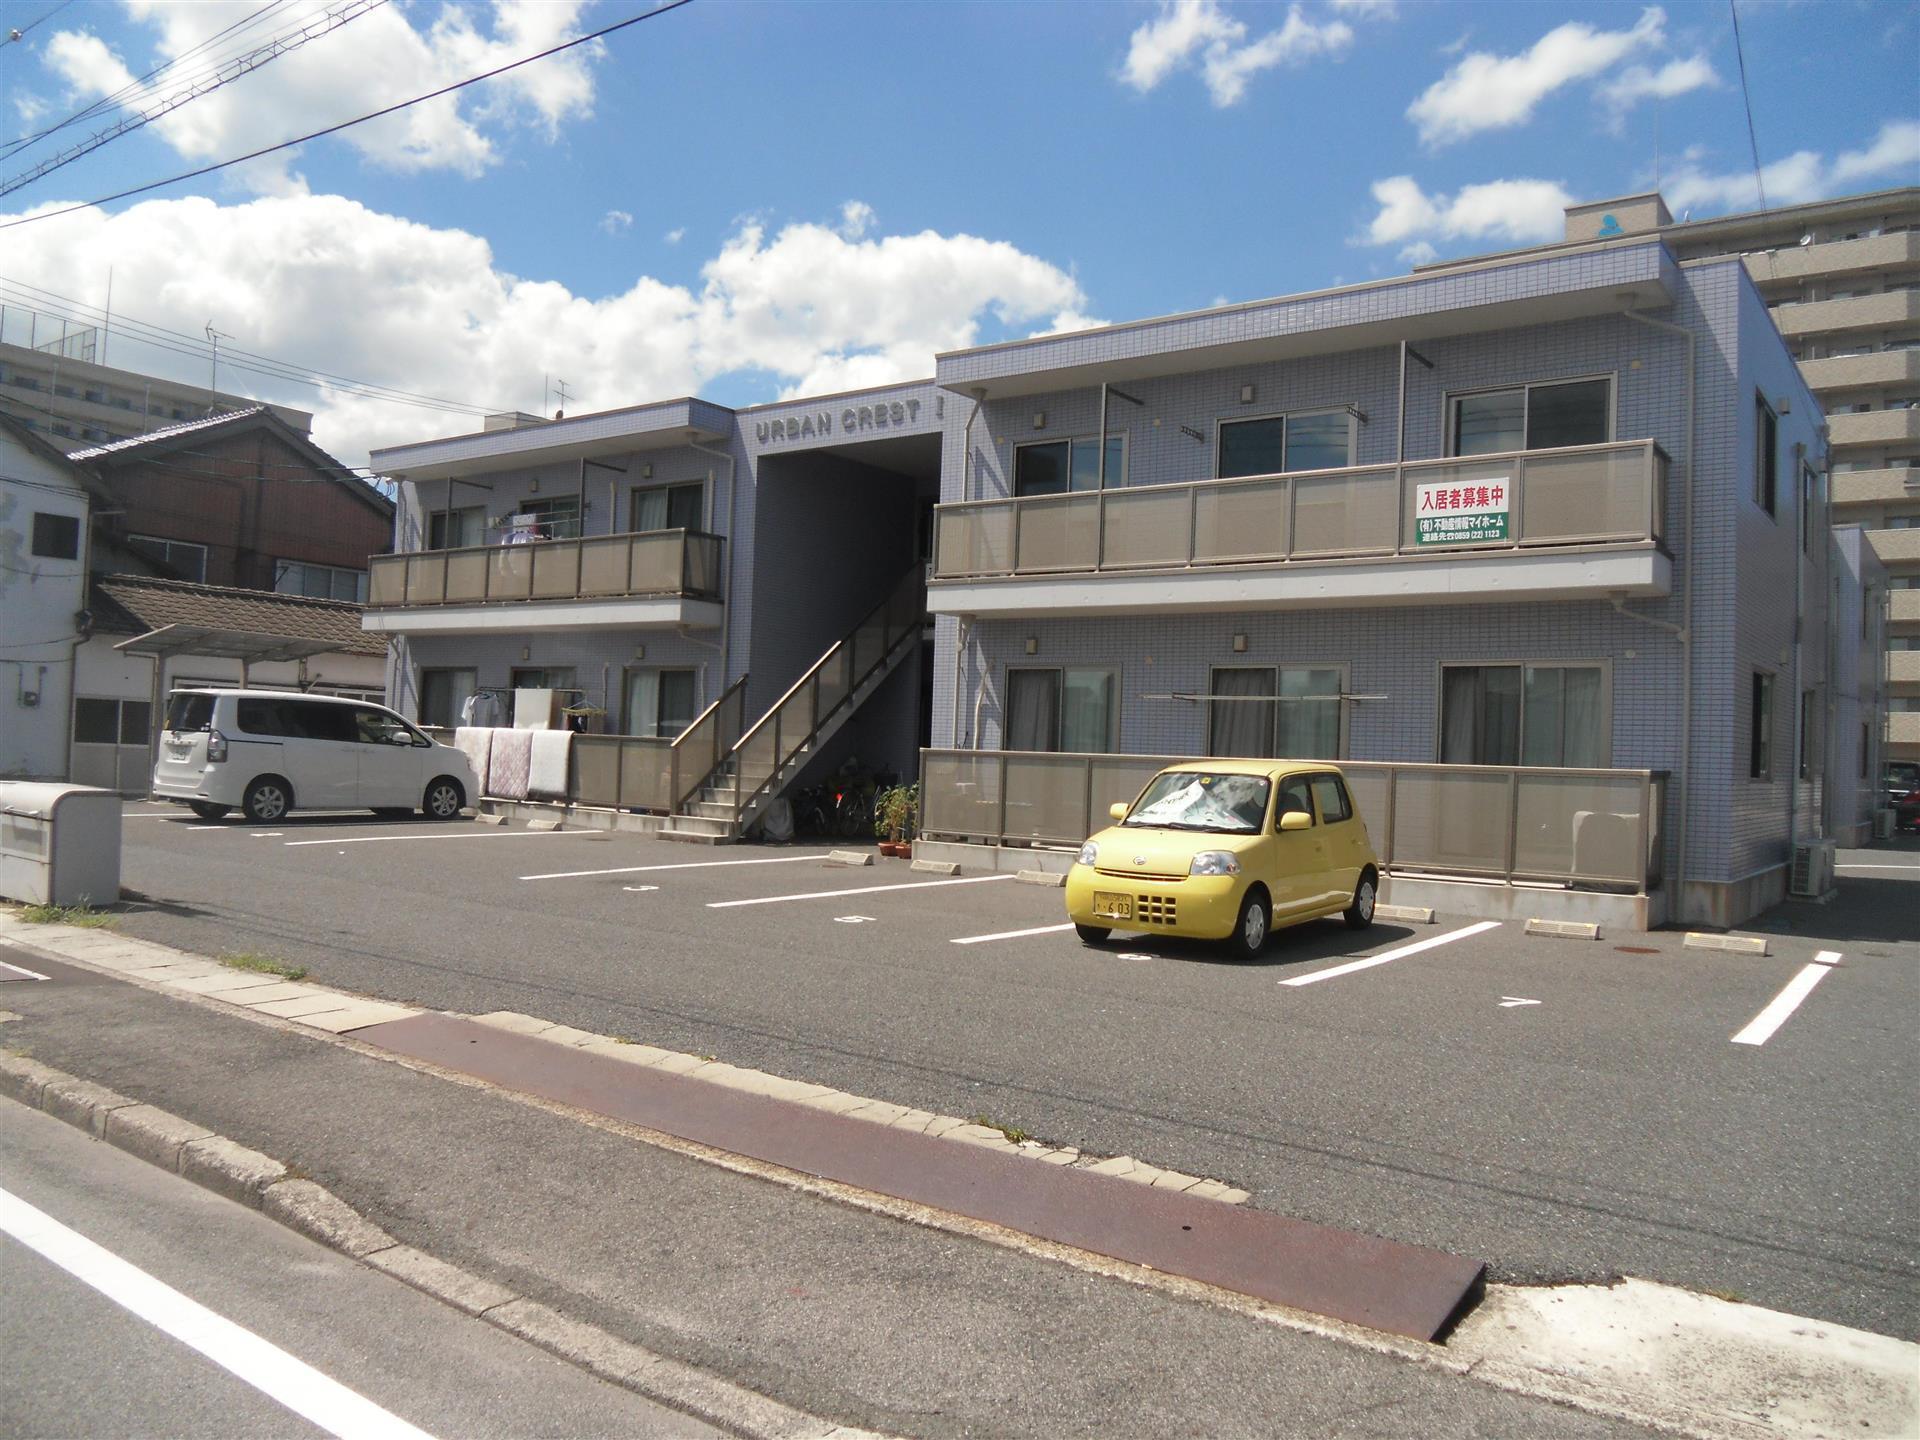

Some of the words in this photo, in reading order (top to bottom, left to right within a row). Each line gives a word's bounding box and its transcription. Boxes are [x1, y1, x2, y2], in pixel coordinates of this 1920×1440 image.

[756, 411, 832, 442] URBAN
[841, 398, 920, 432] CREST
[1421, 485, 1504, 511] 入居者募集中
